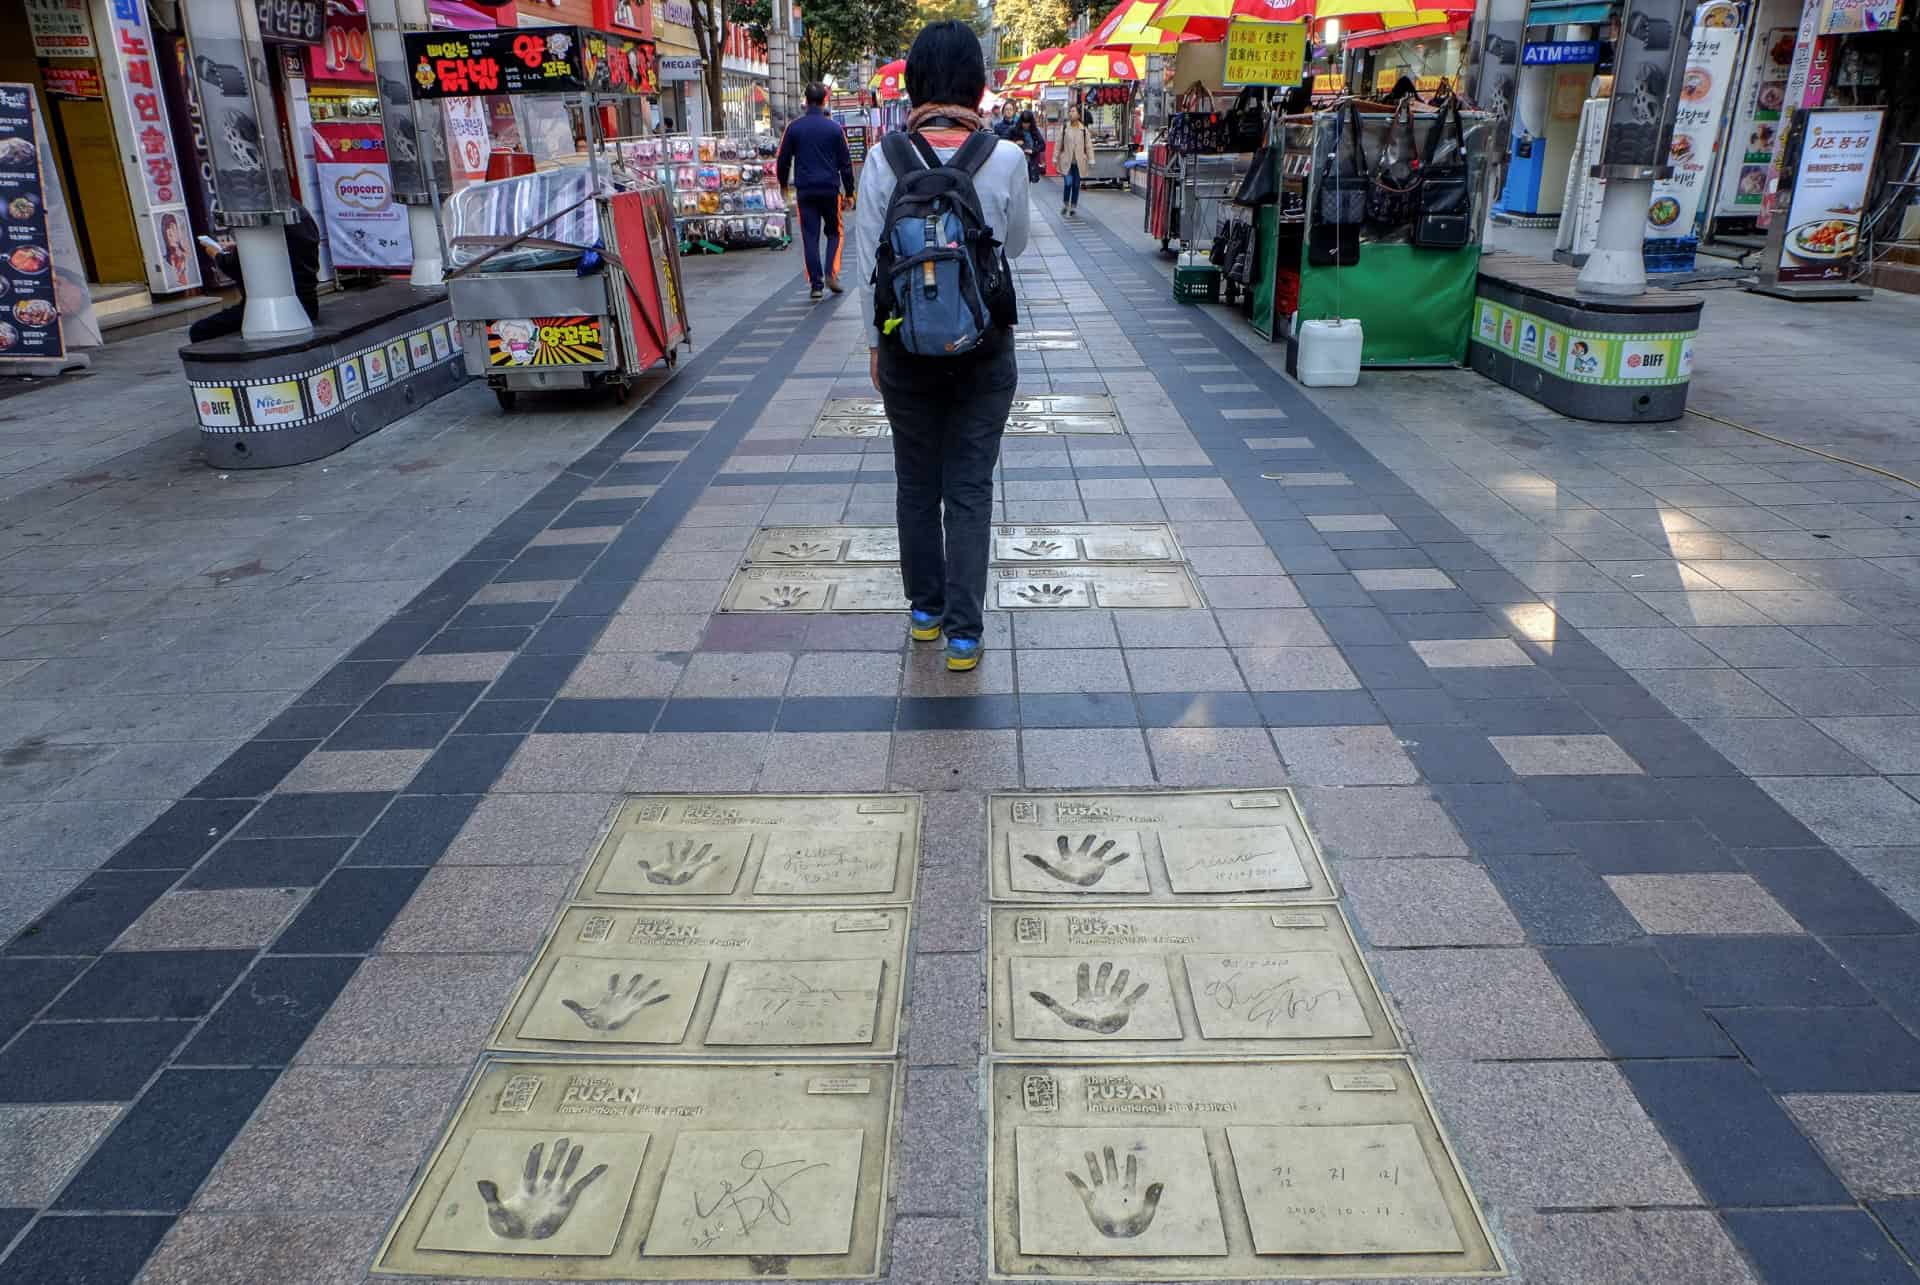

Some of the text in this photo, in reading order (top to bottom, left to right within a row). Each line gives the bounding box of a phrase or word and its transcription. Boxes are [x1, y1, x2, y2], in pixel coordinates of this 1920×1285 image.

[512, 34, 545, 68] 양
[1524, 46, 1562, 62] ATM
[435, 57, 500, 92] 닭발
[340, 184, 384, 196] popcorn
[540, 325, 599, 348] 양꼬치
[1642, 353, 1664, 367] BIFF
[211, 400, 231, 416] BIFF
[562, 1086, 641, 1104] PUSAN
[1086, 1084, 1163, 1101] PUSAN
